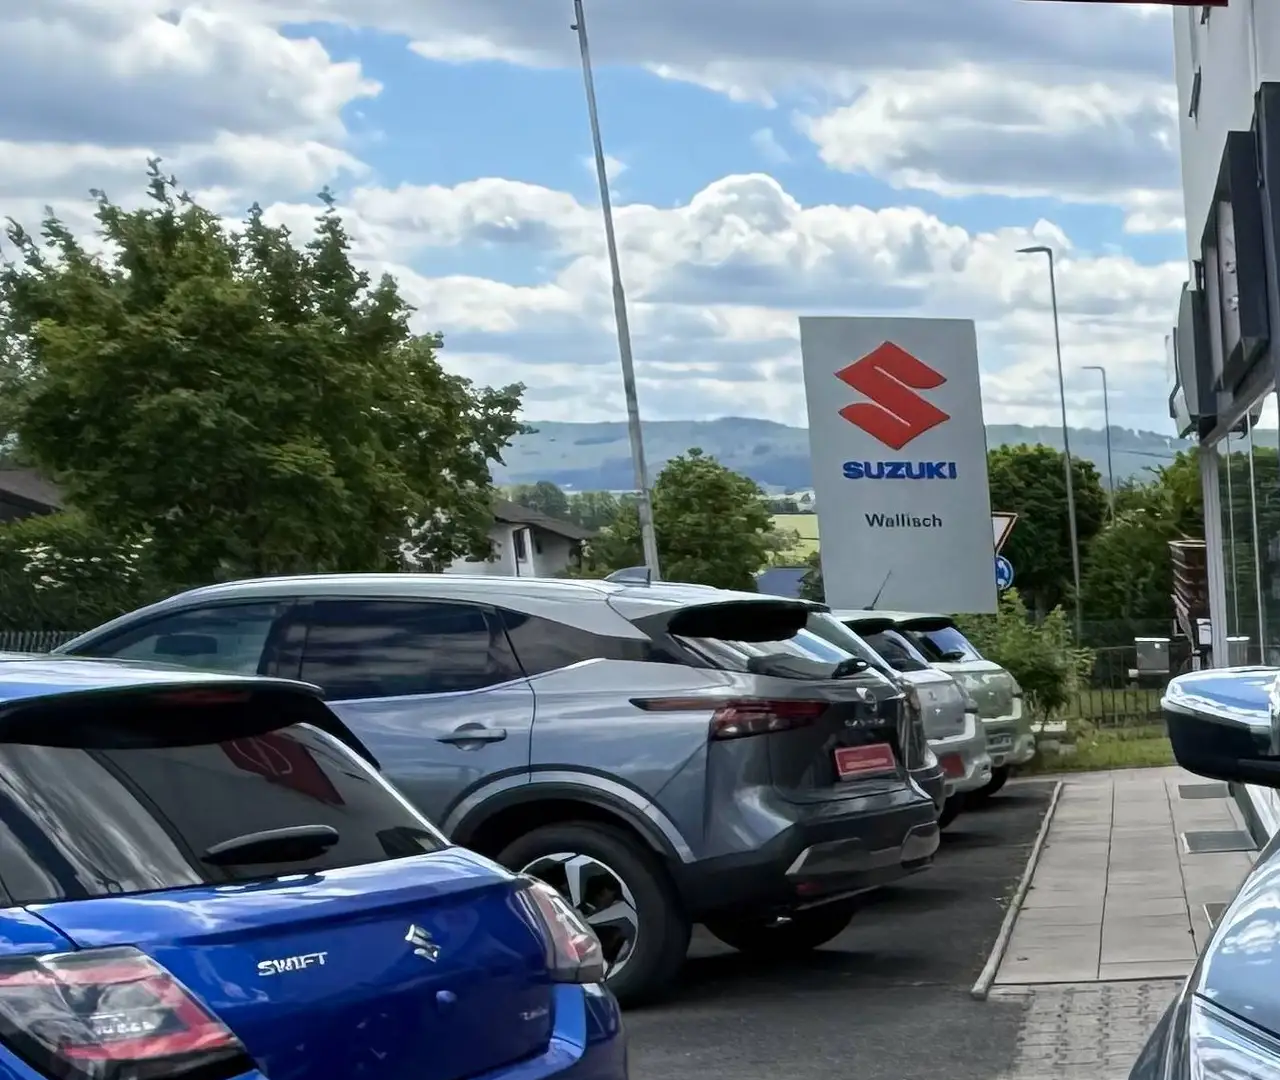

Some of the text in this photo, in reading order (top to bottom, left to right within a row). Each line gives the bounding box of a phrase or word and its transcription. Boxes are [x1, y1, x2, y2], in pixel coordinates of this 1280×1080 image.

[842, 461, 957, 480] SUZUKI
[864, 512, 943, 528] Wallisch
[256, 951, 328, 977] SWIFT
